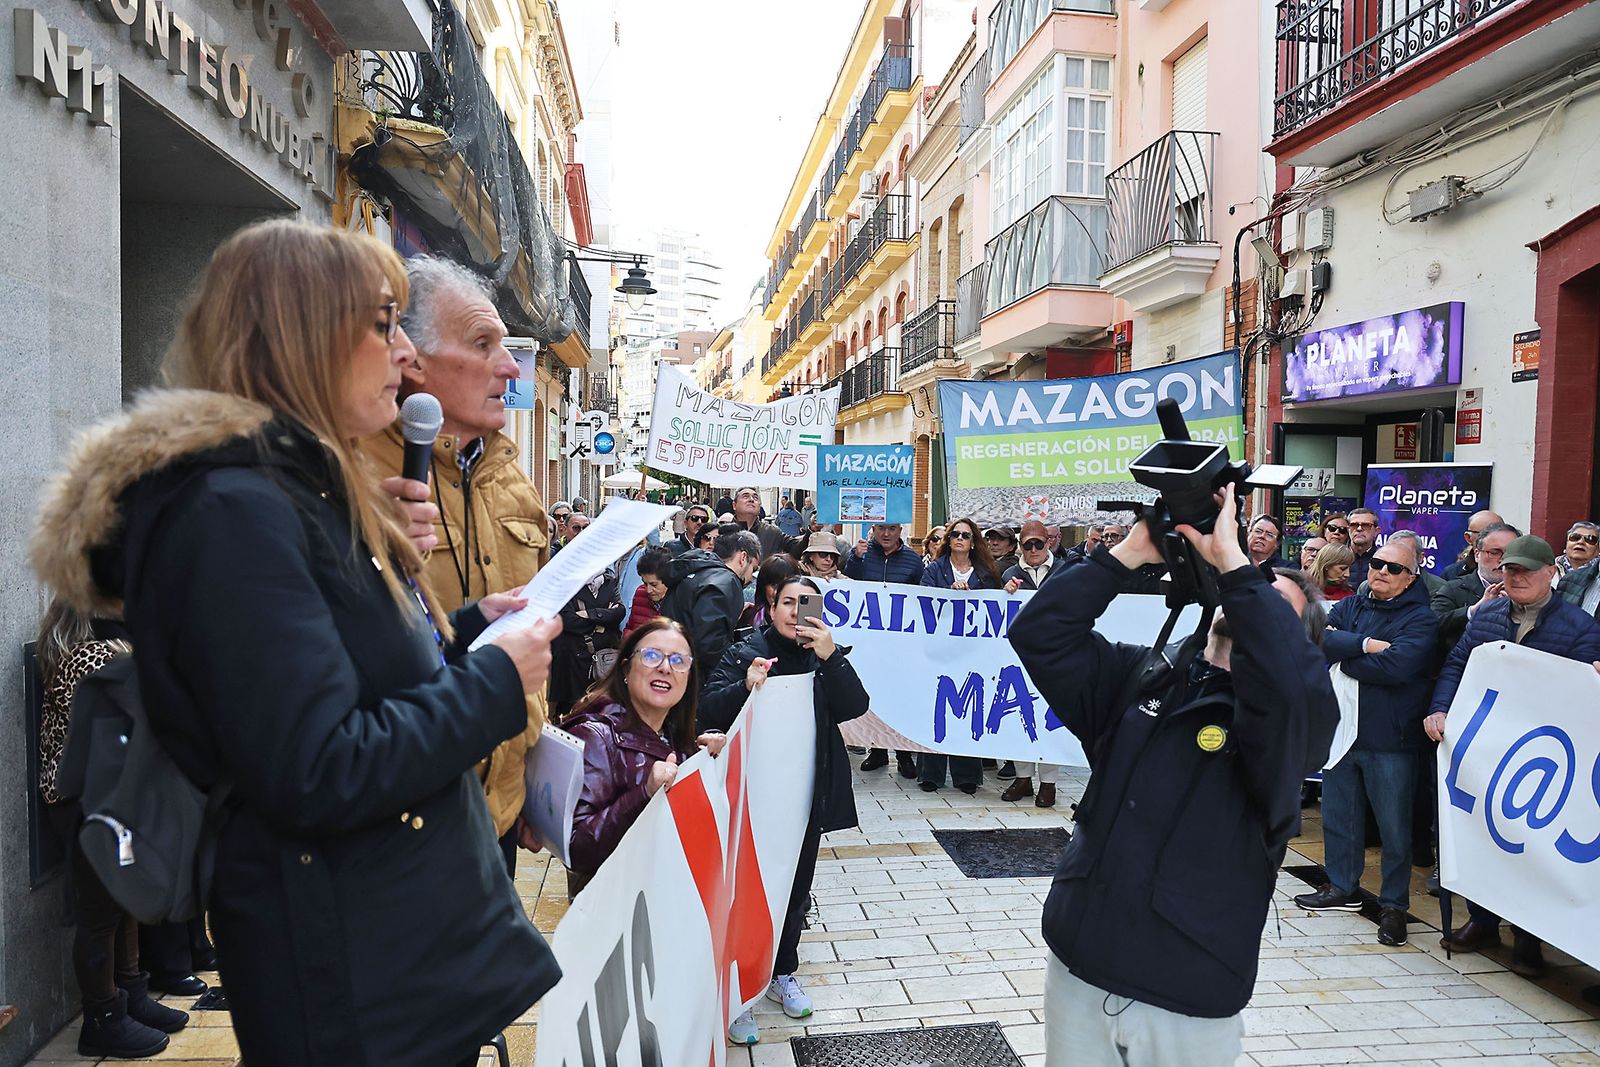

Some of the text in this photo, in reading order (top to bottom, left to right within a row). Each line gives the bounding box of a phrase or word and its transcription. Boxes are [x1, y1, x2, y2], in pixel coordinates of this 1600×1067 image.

[1306, 325, 1413, 369] PLANETA
[668, 416, 791, 450] SOLUCIÓN
[961, 435, 1111, 459] REGENERACIÓN
[825, 447, 912, 474] MAZAGÓN
[1009, 456, 1130, 479] ES LA SOLU
[842, 478, 852, 486] EL
[1379, 484, 1477, 506] Planeta
[1411, 507, 1439, 515] VAPER
[822, 588, 1022, 639] SALVEM
